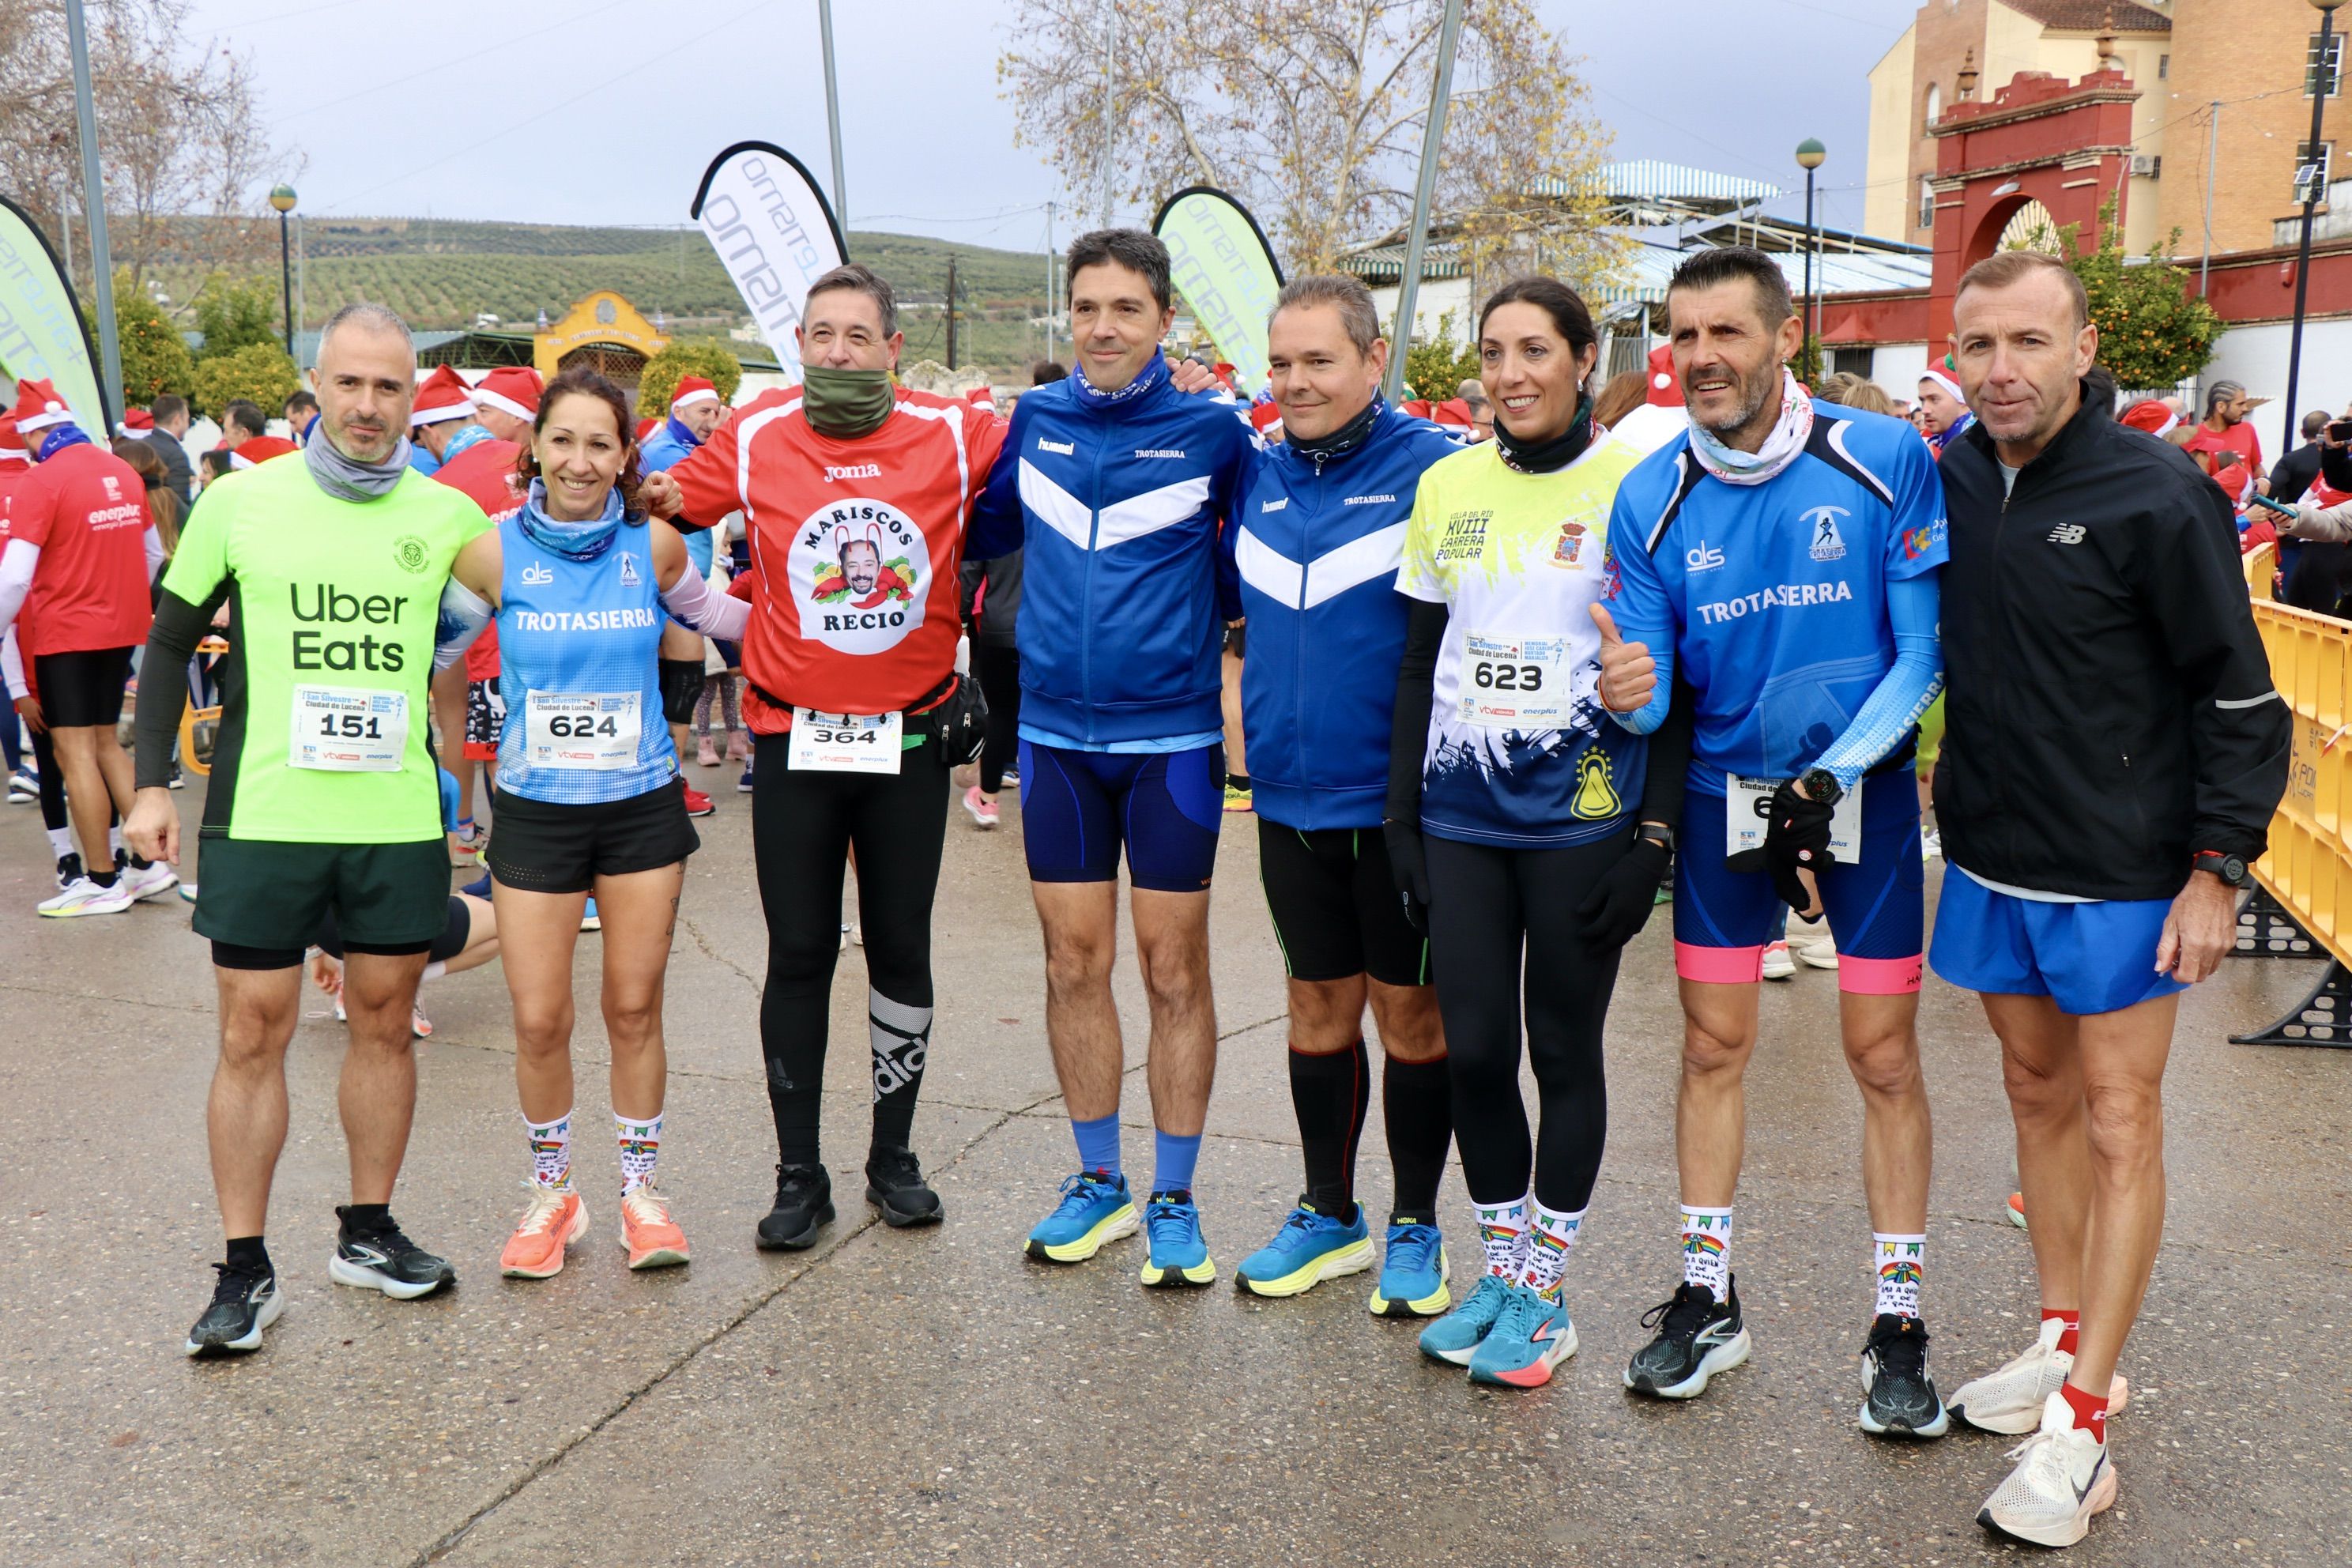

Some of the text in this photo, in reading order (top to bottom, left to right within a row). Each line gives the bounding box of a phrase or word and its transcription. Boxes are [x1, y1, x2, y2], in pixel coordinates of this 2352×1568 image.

[1038, 437, 1074, 455] hummel
[1135, 450, 1185, 458] TROTASIERRA
[1344, 495, 1396, 506] TROTASIERRA
[1450, 511, 1467, 520] VILLA
[805, 507, 913, 550] MARISCOS
[1440, 536, 1484, 548] CARRERA
[1435, 548, 1482, 560] POPULAR
[291, 582, 408, 624] Uber
[516, 608, 656, 631] TROTASIERRA
[824, 611, 905, 631] RECIO
[293, 631, 404, 673] Eats
[1468, 647, 1485, 656] Ciudad
[1493, 650, 1517, 659] Lucena
[1476, 662, 1542, 691] 623
[320, 714, 383, 739] 151
[549, 715, 617, 737] 624
[1860, 671, 1946, 771] TROTASIERRA
[814, 729, 876, 744] 364
[1740, 782, 1766, 791] Ciudad
[1301, 1201, 1316, 1213] HOKA
[1537, 1250, 1561, 1262] QUIEN
[1698, 1257, 1719, 1268] QUIEN
[1892, 1300, 1916, 1310] GANA
